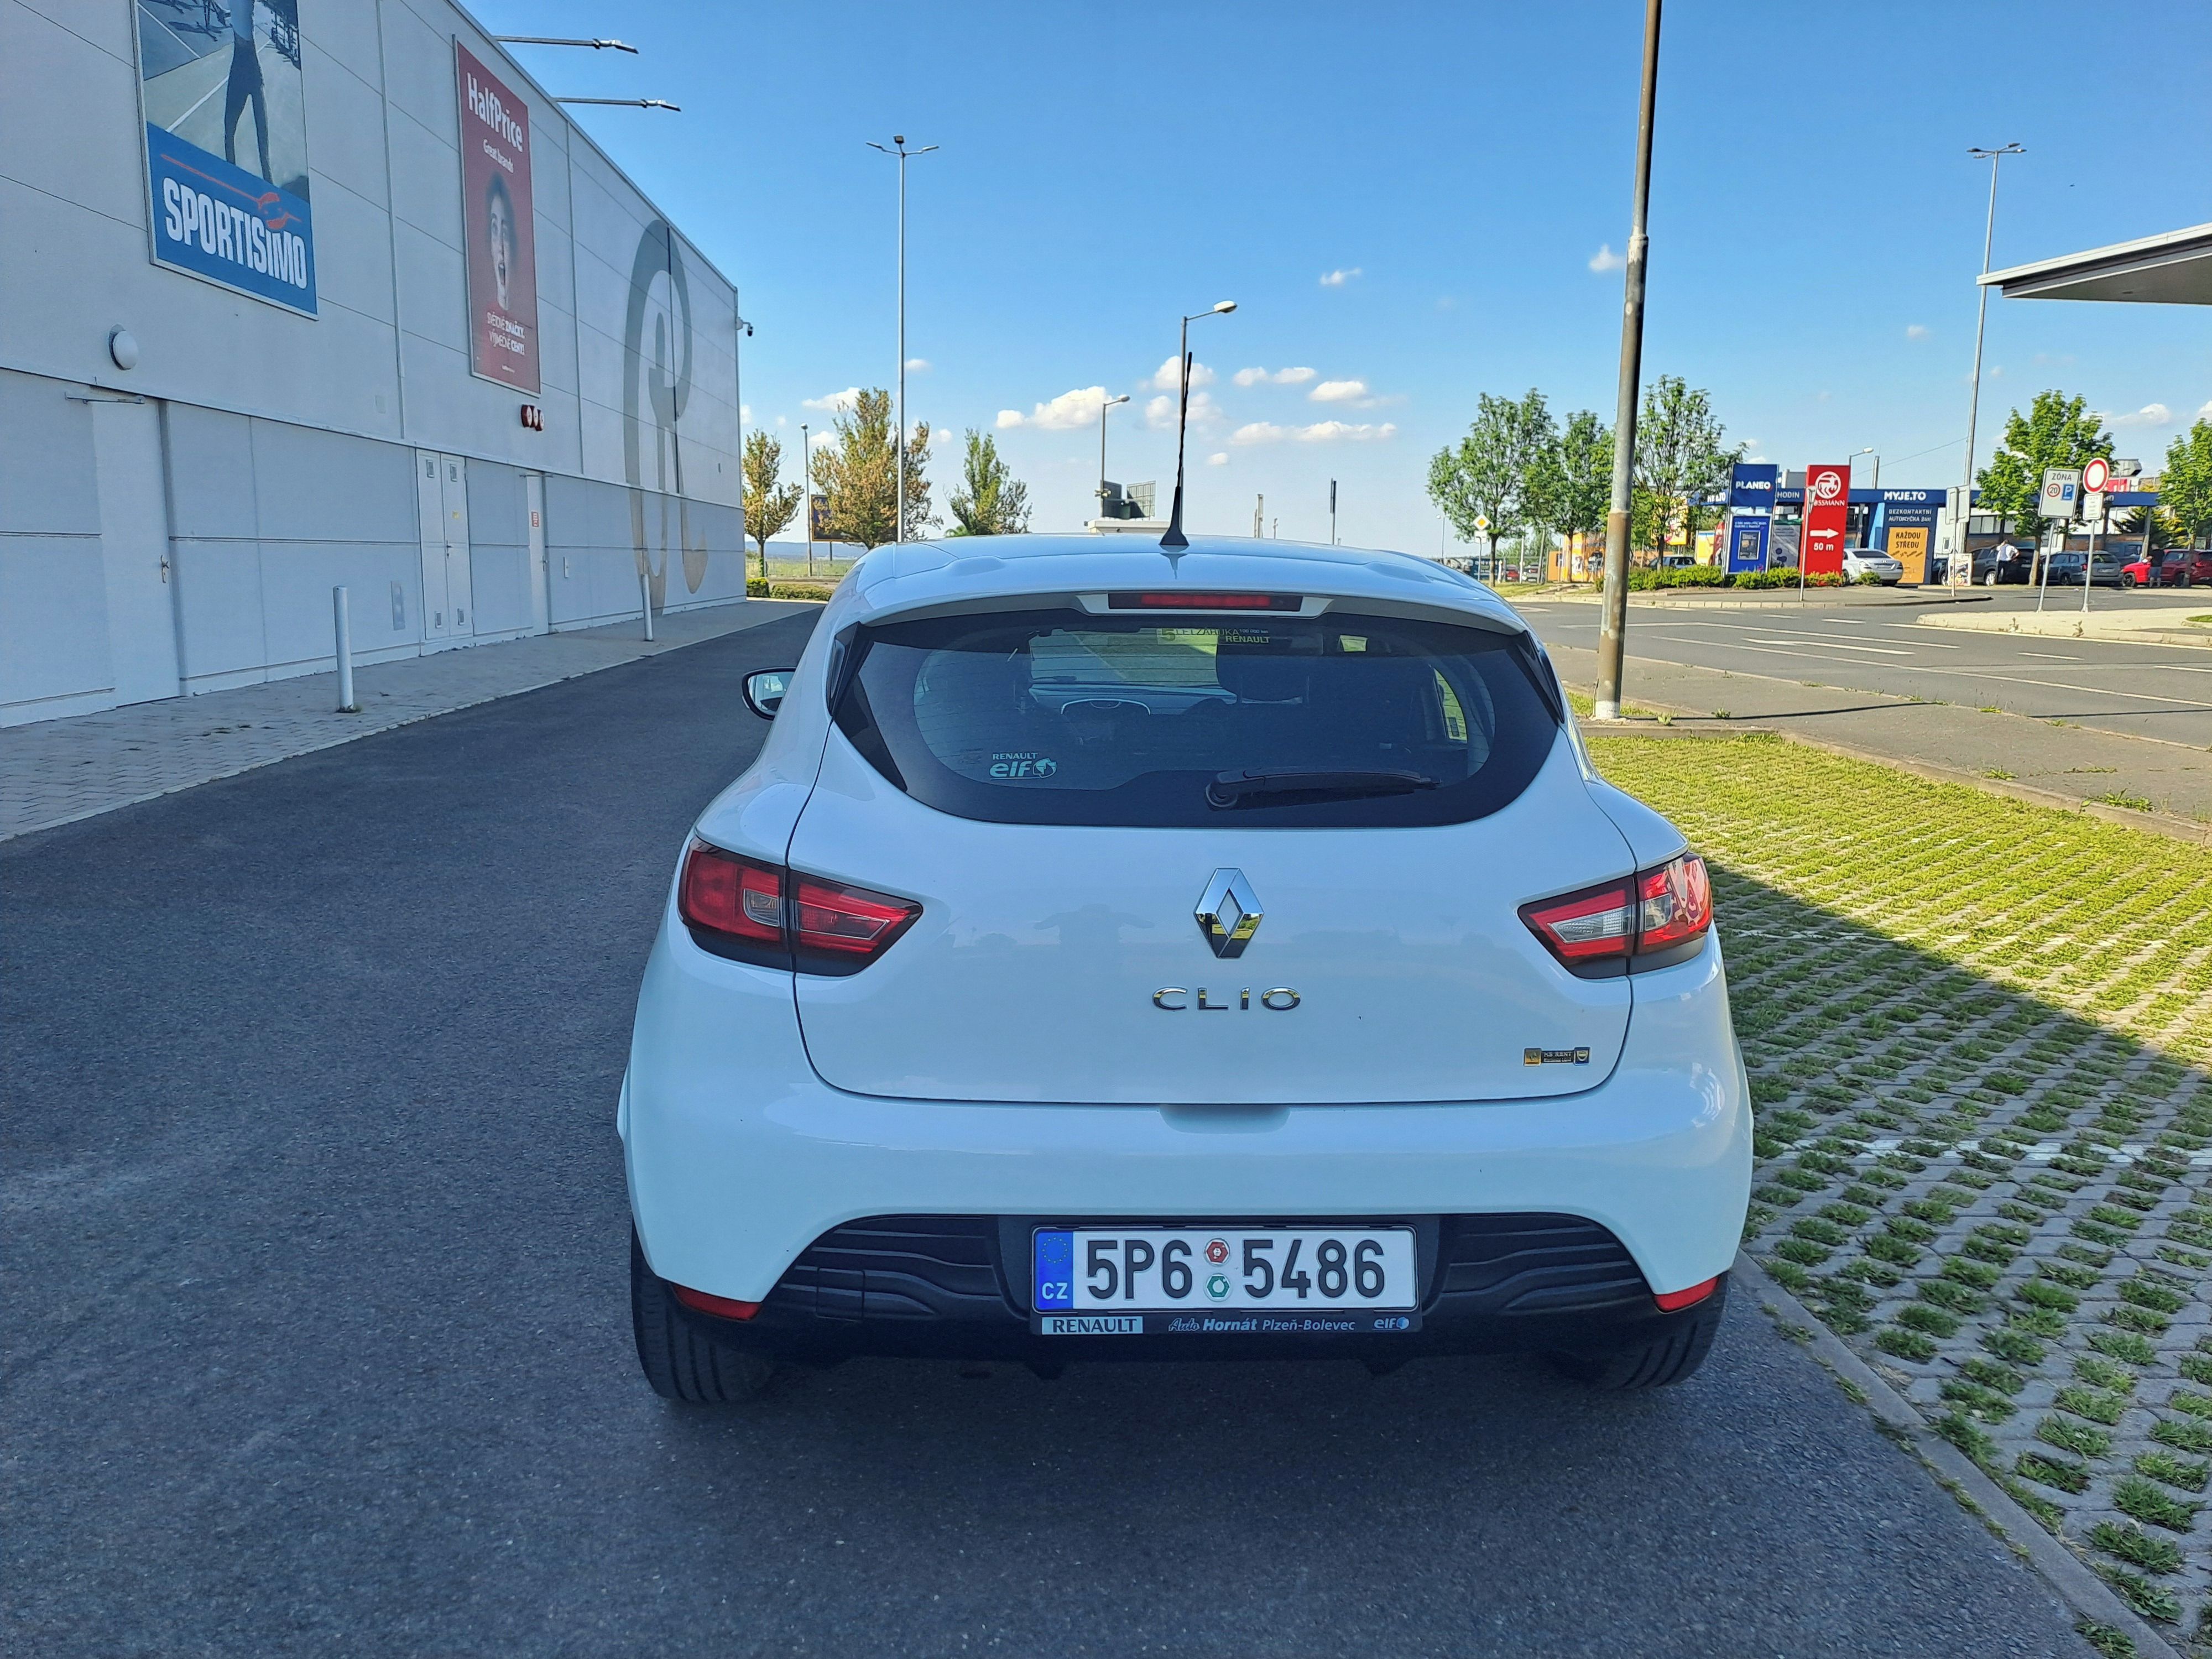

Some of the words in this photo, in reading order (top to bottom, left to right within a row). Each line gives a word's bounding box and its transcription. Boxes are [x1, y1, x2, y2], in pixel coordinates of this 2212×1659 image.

[467, 72, 523, 152] HalfPrice
[163, 177, 307, 289] SPORTISIMO
[1735, 481, 1771, 489] PLANEO
[1884, 491, 1926, 501] MYJE.TO
[1813, 542, 1824, 551] 50
[1162, 628, 1176, 641] 5
[990, 760, 1032, 778] elf
[1152, 987, 1301, 1010] CLIO
[1087, 1239, 1192, 1299] 5P6
[1243, 1239, 1385, 1298] 5486
[1042, 1282, 1068, 1300] CZ
[1052, 1319, 1137, 1333] RENAULT
[1168, 1317, 1200, 1332] Auto
[1202, 1318, 1257, 1331] Hornát
[1262, 1319, 1355, 1331] Plzeň-Bolevec
[1374, 1318, 1398, 1328] elf
